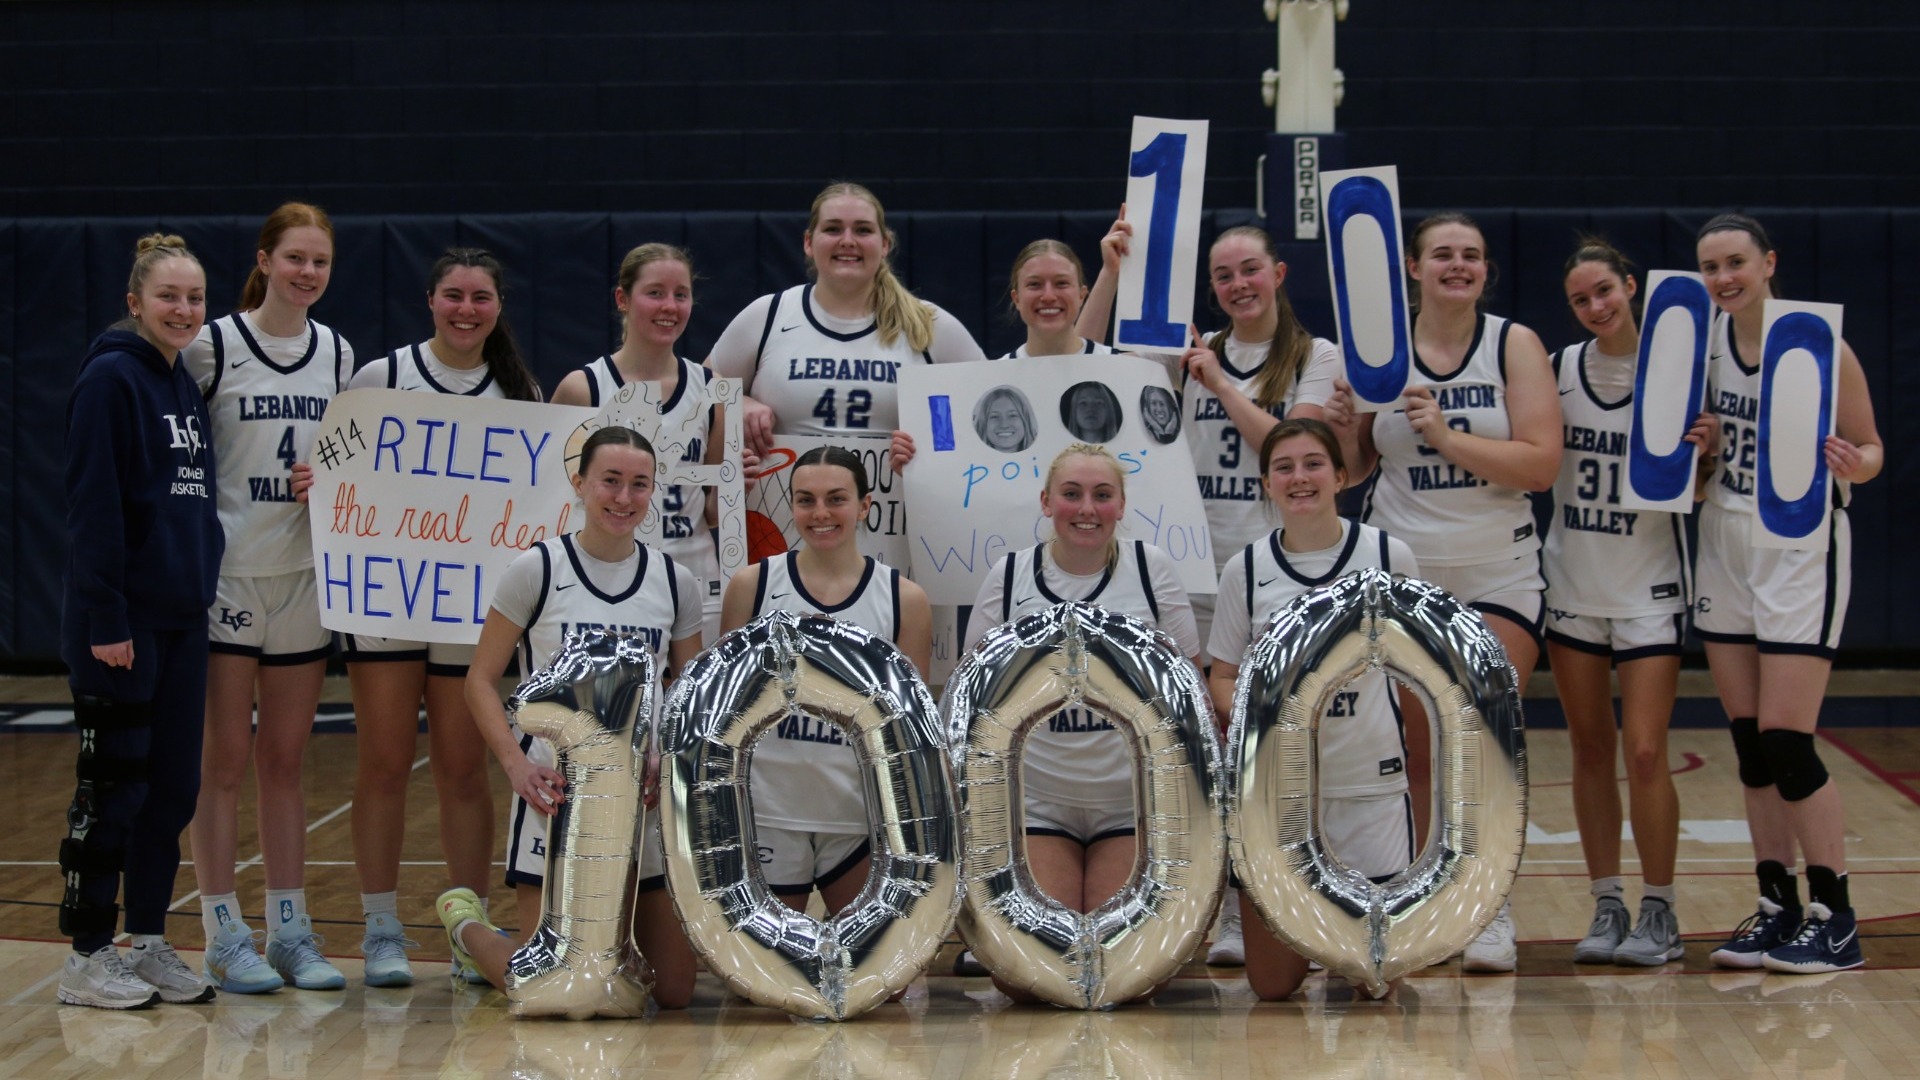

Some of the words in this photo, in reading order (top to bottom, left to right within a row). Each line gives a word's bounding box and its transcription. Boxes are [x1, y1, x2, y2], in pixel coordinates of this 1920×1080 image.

[1118, 131, 1188, 348] 1
[788, 358, 901, 384] LEBANON
[239, 395, 328, 422] LEBANON
[812, 388, 872, 429] 42
[1194, 397, 1286, 421] LEBN
[1430, 385, 1496, 411] ANON
[1714, 388, 1758, 422] LEBAN
[277, 425, 297, 470] 4
[317, 418, 367, 470] #14
[374, 416, 551, 486] RILEY
[1218, 426, 1242, 469] 3
[1563, 424, 1628, 457] LEBAN
[1723, 421, 1757, 470] 32
[248, 477, 298, 503] VALL
[962, 450, 1143, 508] pois
[1409, 463, 1489, 491] VALLE
[1577, 458, 1621, 504] 31
[330, 482, 380, 537] the
[395, 494, 471, 543] real
[1563, 504, 1638, 536] VALLEY
[777, 714, 852, 747] VALLE
[1048, 708, 1117, 733] VALL
